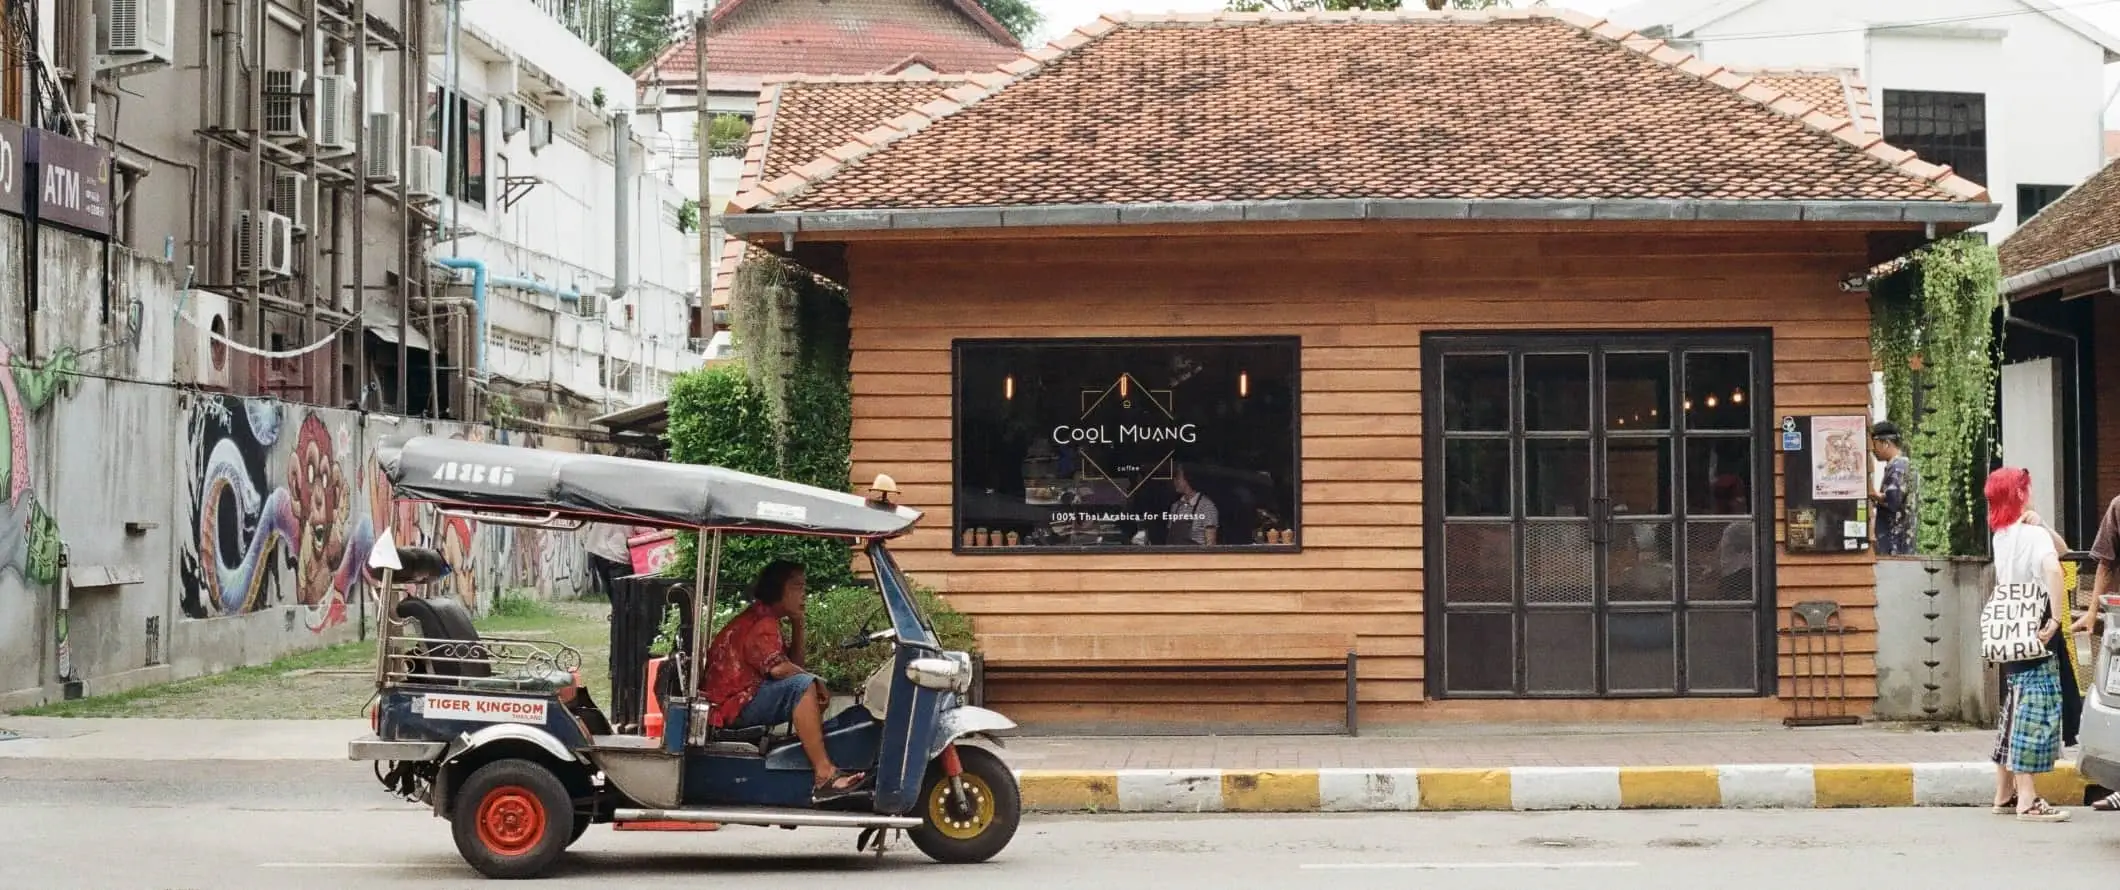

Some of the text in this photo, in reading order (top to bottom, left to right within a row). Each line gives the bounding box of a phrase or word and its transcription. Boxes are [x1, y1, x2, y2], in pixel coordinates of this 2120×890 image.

[44, 164, 80, 211] ATM
[1051, 512, 1206, 522] 100% Thai Arabica for Espresso
[428, 698, 470, 711] TIGER
[476, 701, 543, 714] KINGDOM
